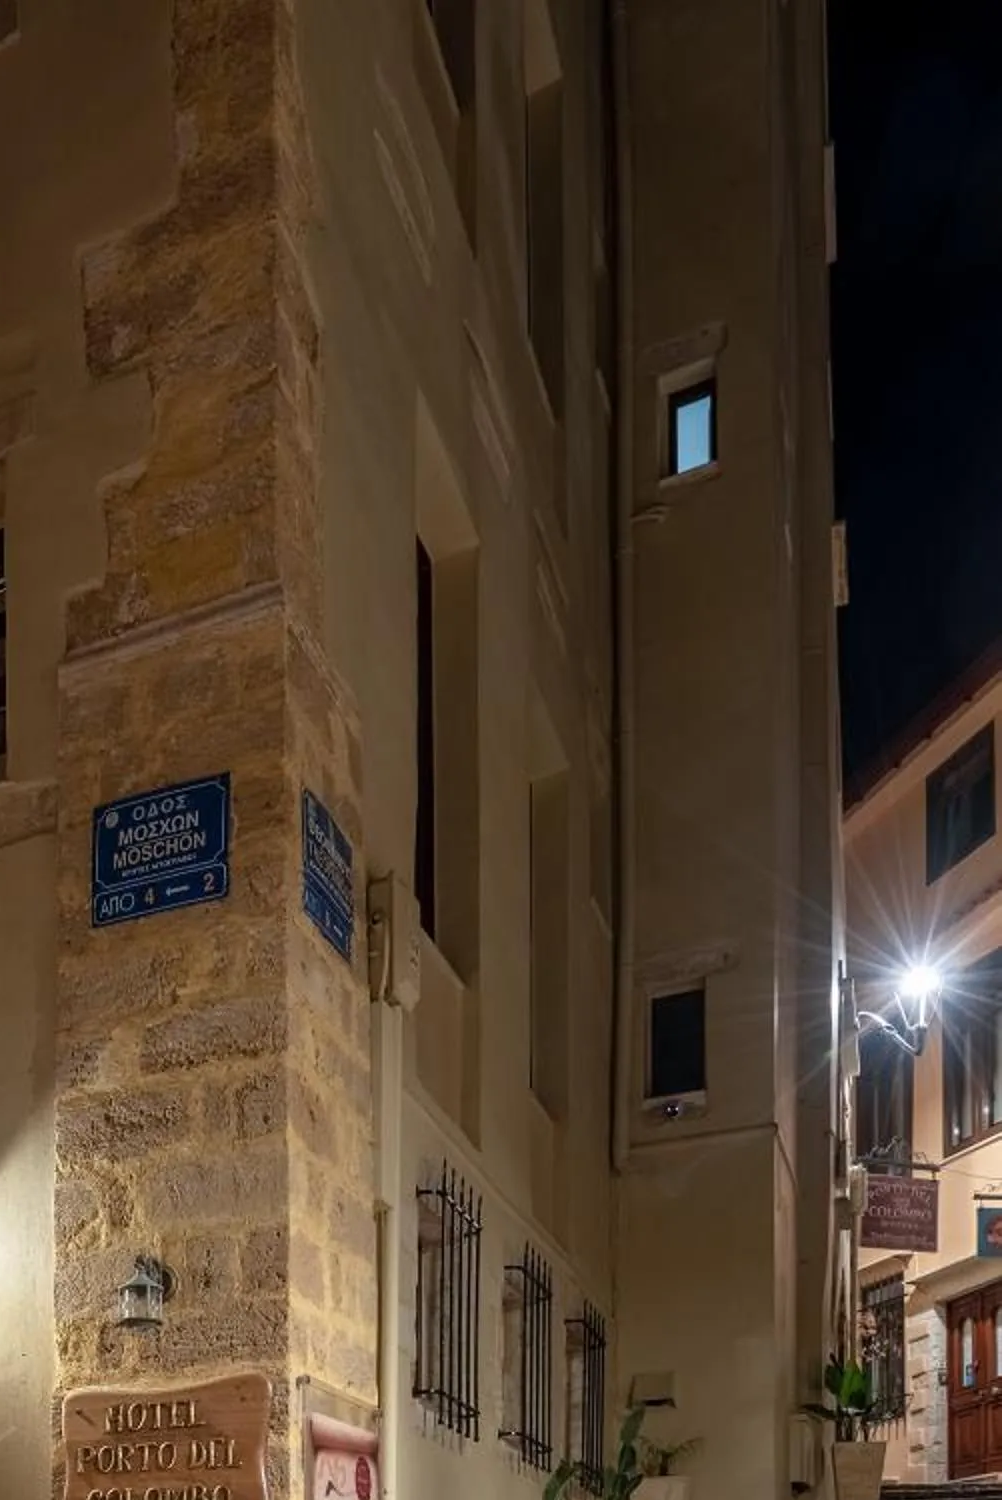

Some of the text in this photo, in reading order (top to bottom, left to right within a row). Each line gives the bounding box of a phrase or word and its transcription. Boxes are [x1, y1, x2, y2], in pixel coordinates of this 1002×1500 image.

[132, 794, 188, 821] ΟΔΟΣ
[118, 810, 200, 847] ΜΟΣΧΩΝ
[113, 831, 207, 870] MOSCHON
[99, 872, 216, 919] ΑΠΟ 4 2
[103, 1399, 206, 1434] HOTEL
[75, 1436, 244, 1474] PORTO DEL
